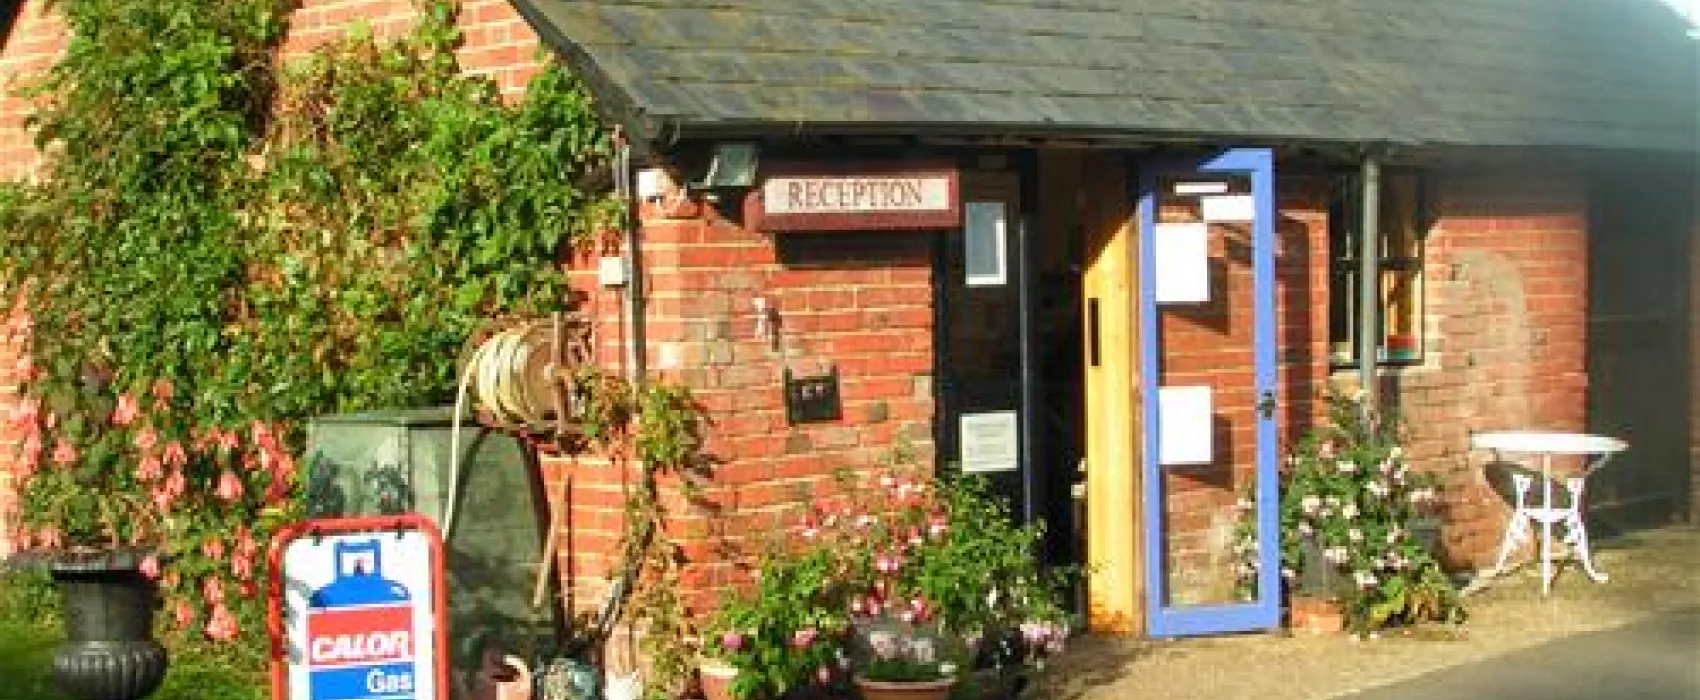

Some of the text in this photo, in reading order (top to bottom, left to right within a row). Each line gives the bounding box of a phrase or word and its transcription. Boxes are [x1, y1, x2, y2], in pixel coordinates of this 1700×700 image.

[787, 180, 923, 209] RECEPTION
[311, 630, 412, 660] CALOR
[366, 667, 413, 693] Gas
